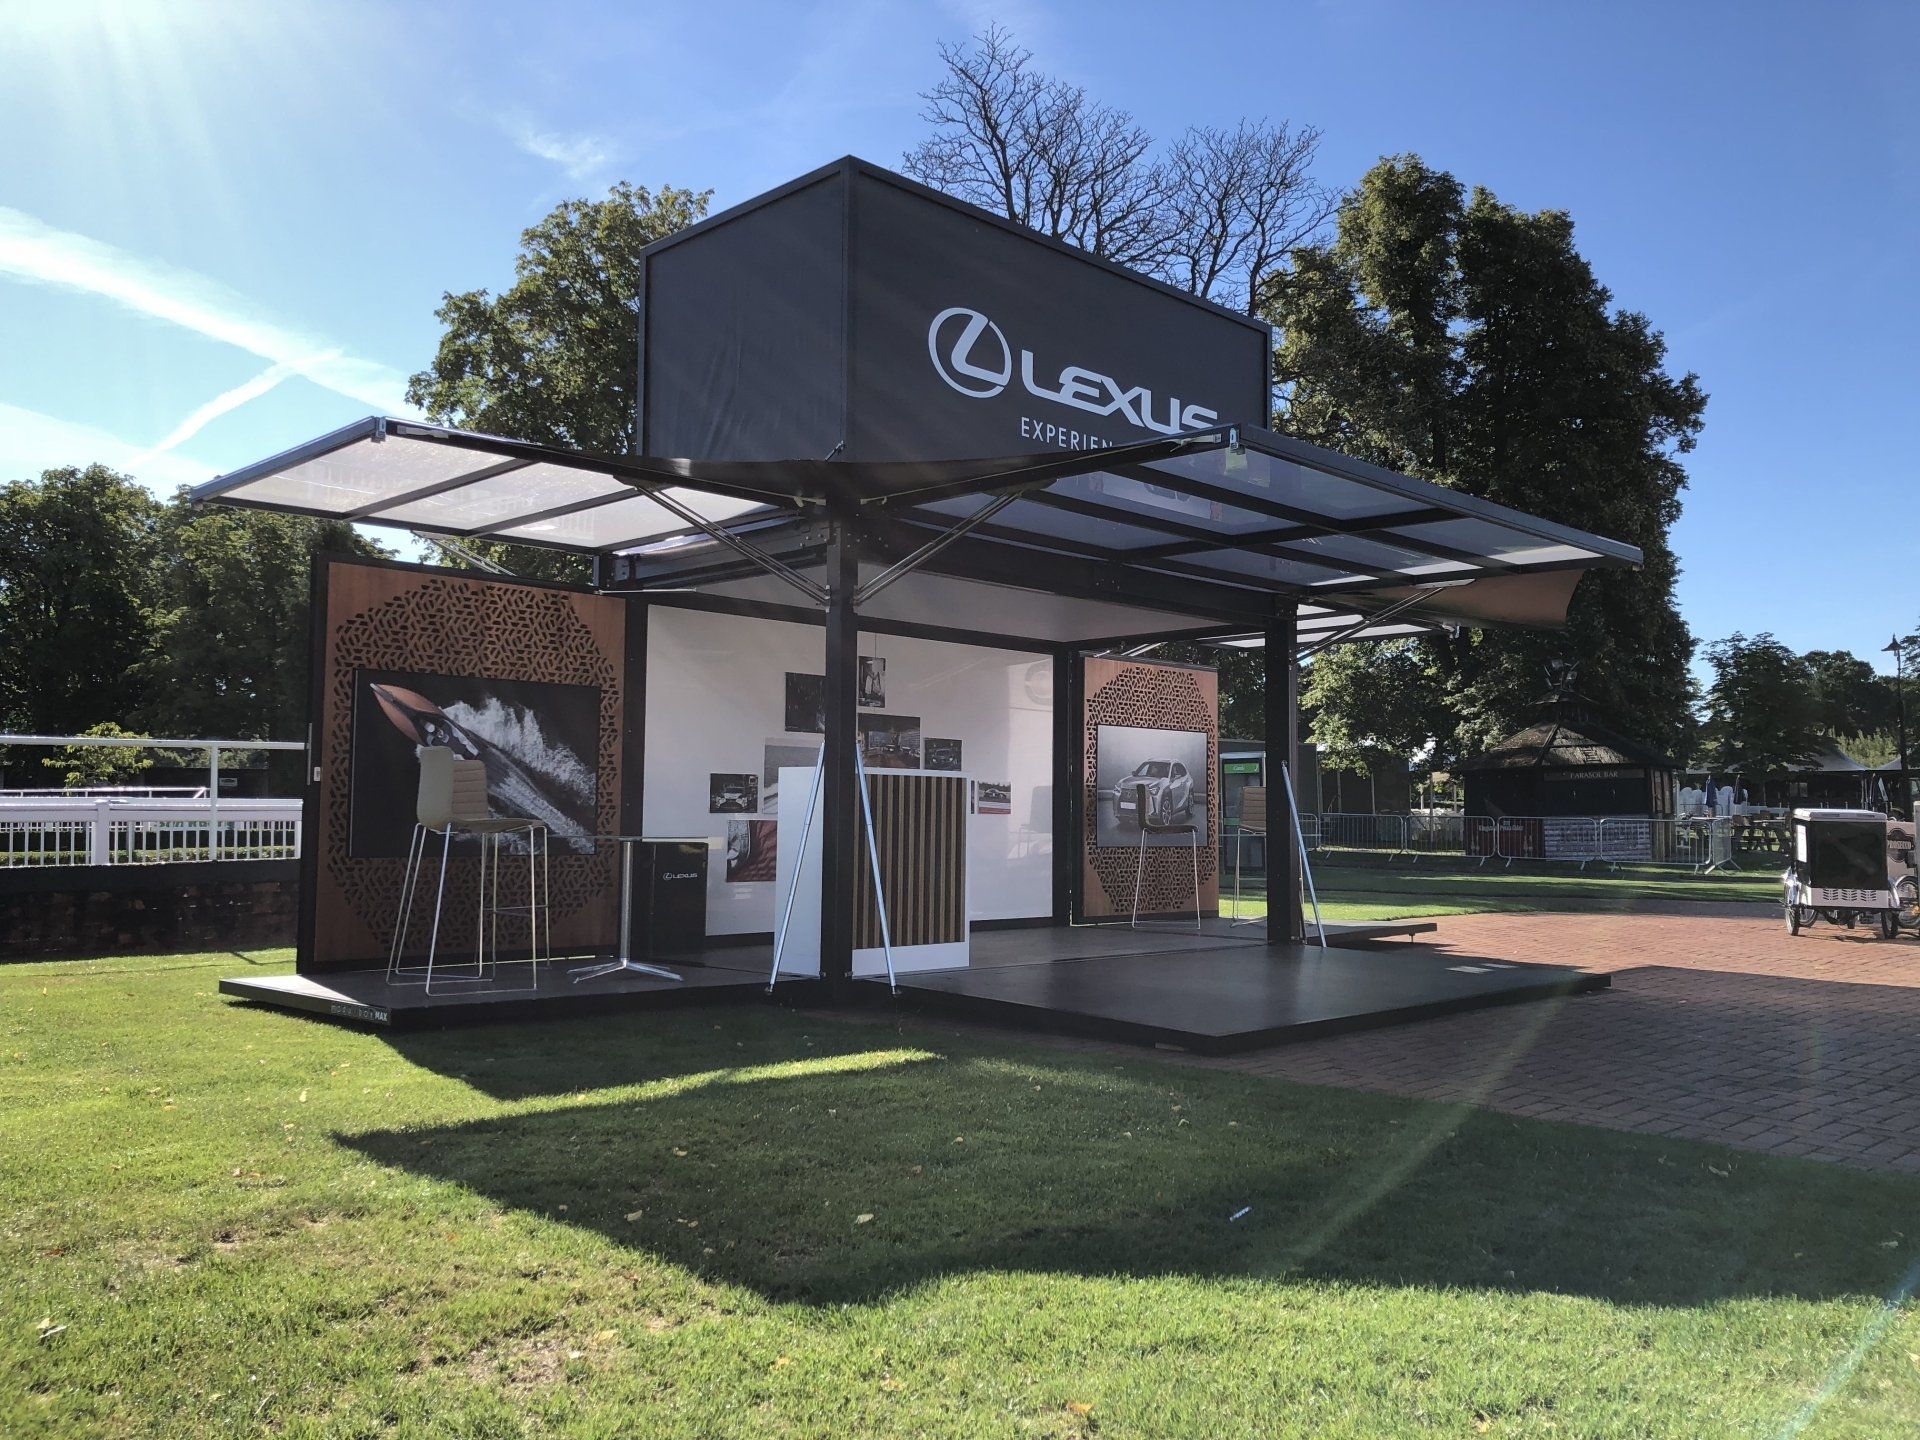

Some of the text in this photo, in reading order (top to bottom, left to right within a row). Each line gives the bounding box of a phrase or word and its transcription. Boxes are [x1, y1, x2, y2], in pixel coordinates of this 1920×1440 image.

[1021, 349, 1218, 435] LEXUS
[1570, 771, 1601, 779] PARASOL
[374, 1010, 388, 1022] MAX
